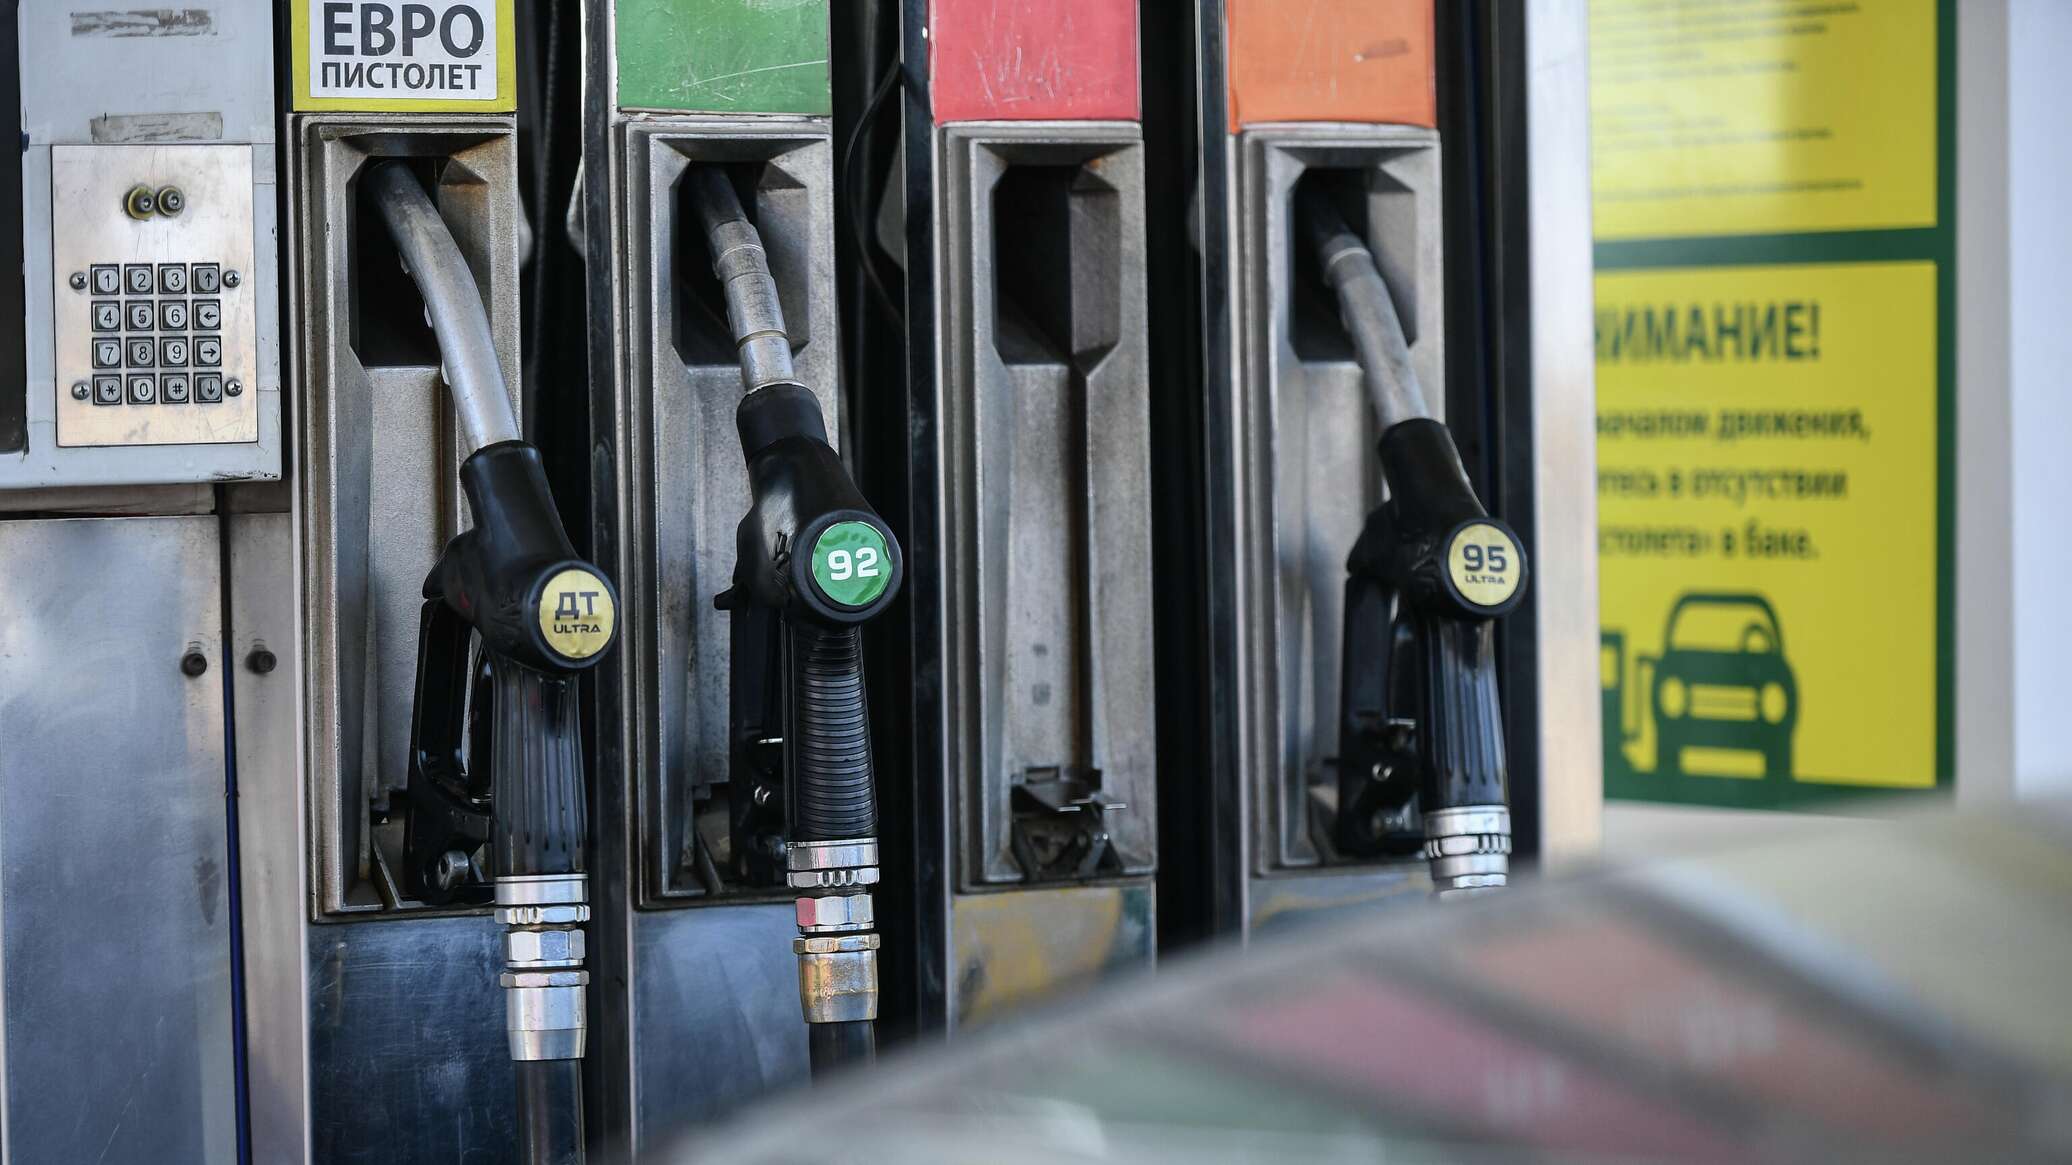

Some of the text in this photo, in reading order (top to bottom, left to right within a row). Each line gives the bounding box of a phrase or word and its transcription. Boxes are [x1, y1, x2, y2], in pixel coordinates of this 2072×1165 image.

[323, 2, 485, 59] ЕВРО
[321, 62, 482, 90] ПИСТОЛЕТ
[104, 272, 180, 288] 1 2 3
[103, 308, 181, 324] 4 5 6
[105, 345, 182, 361] 7 8 9
[139, 382, 149, 397] 0
[1716, 408, 1872, 443] движения,
[1668, 469, 1682, 496] в
[1691, 468, 1848, 507] отсутствии
[827, 547, 879, 581] 92
[1463, 544, 1507, 573] 95
[1465, 575, 1505, 584] ULTRA
[554, 592, 599, 621] ДТ
[553, 624, 601, 634] ULTRA
